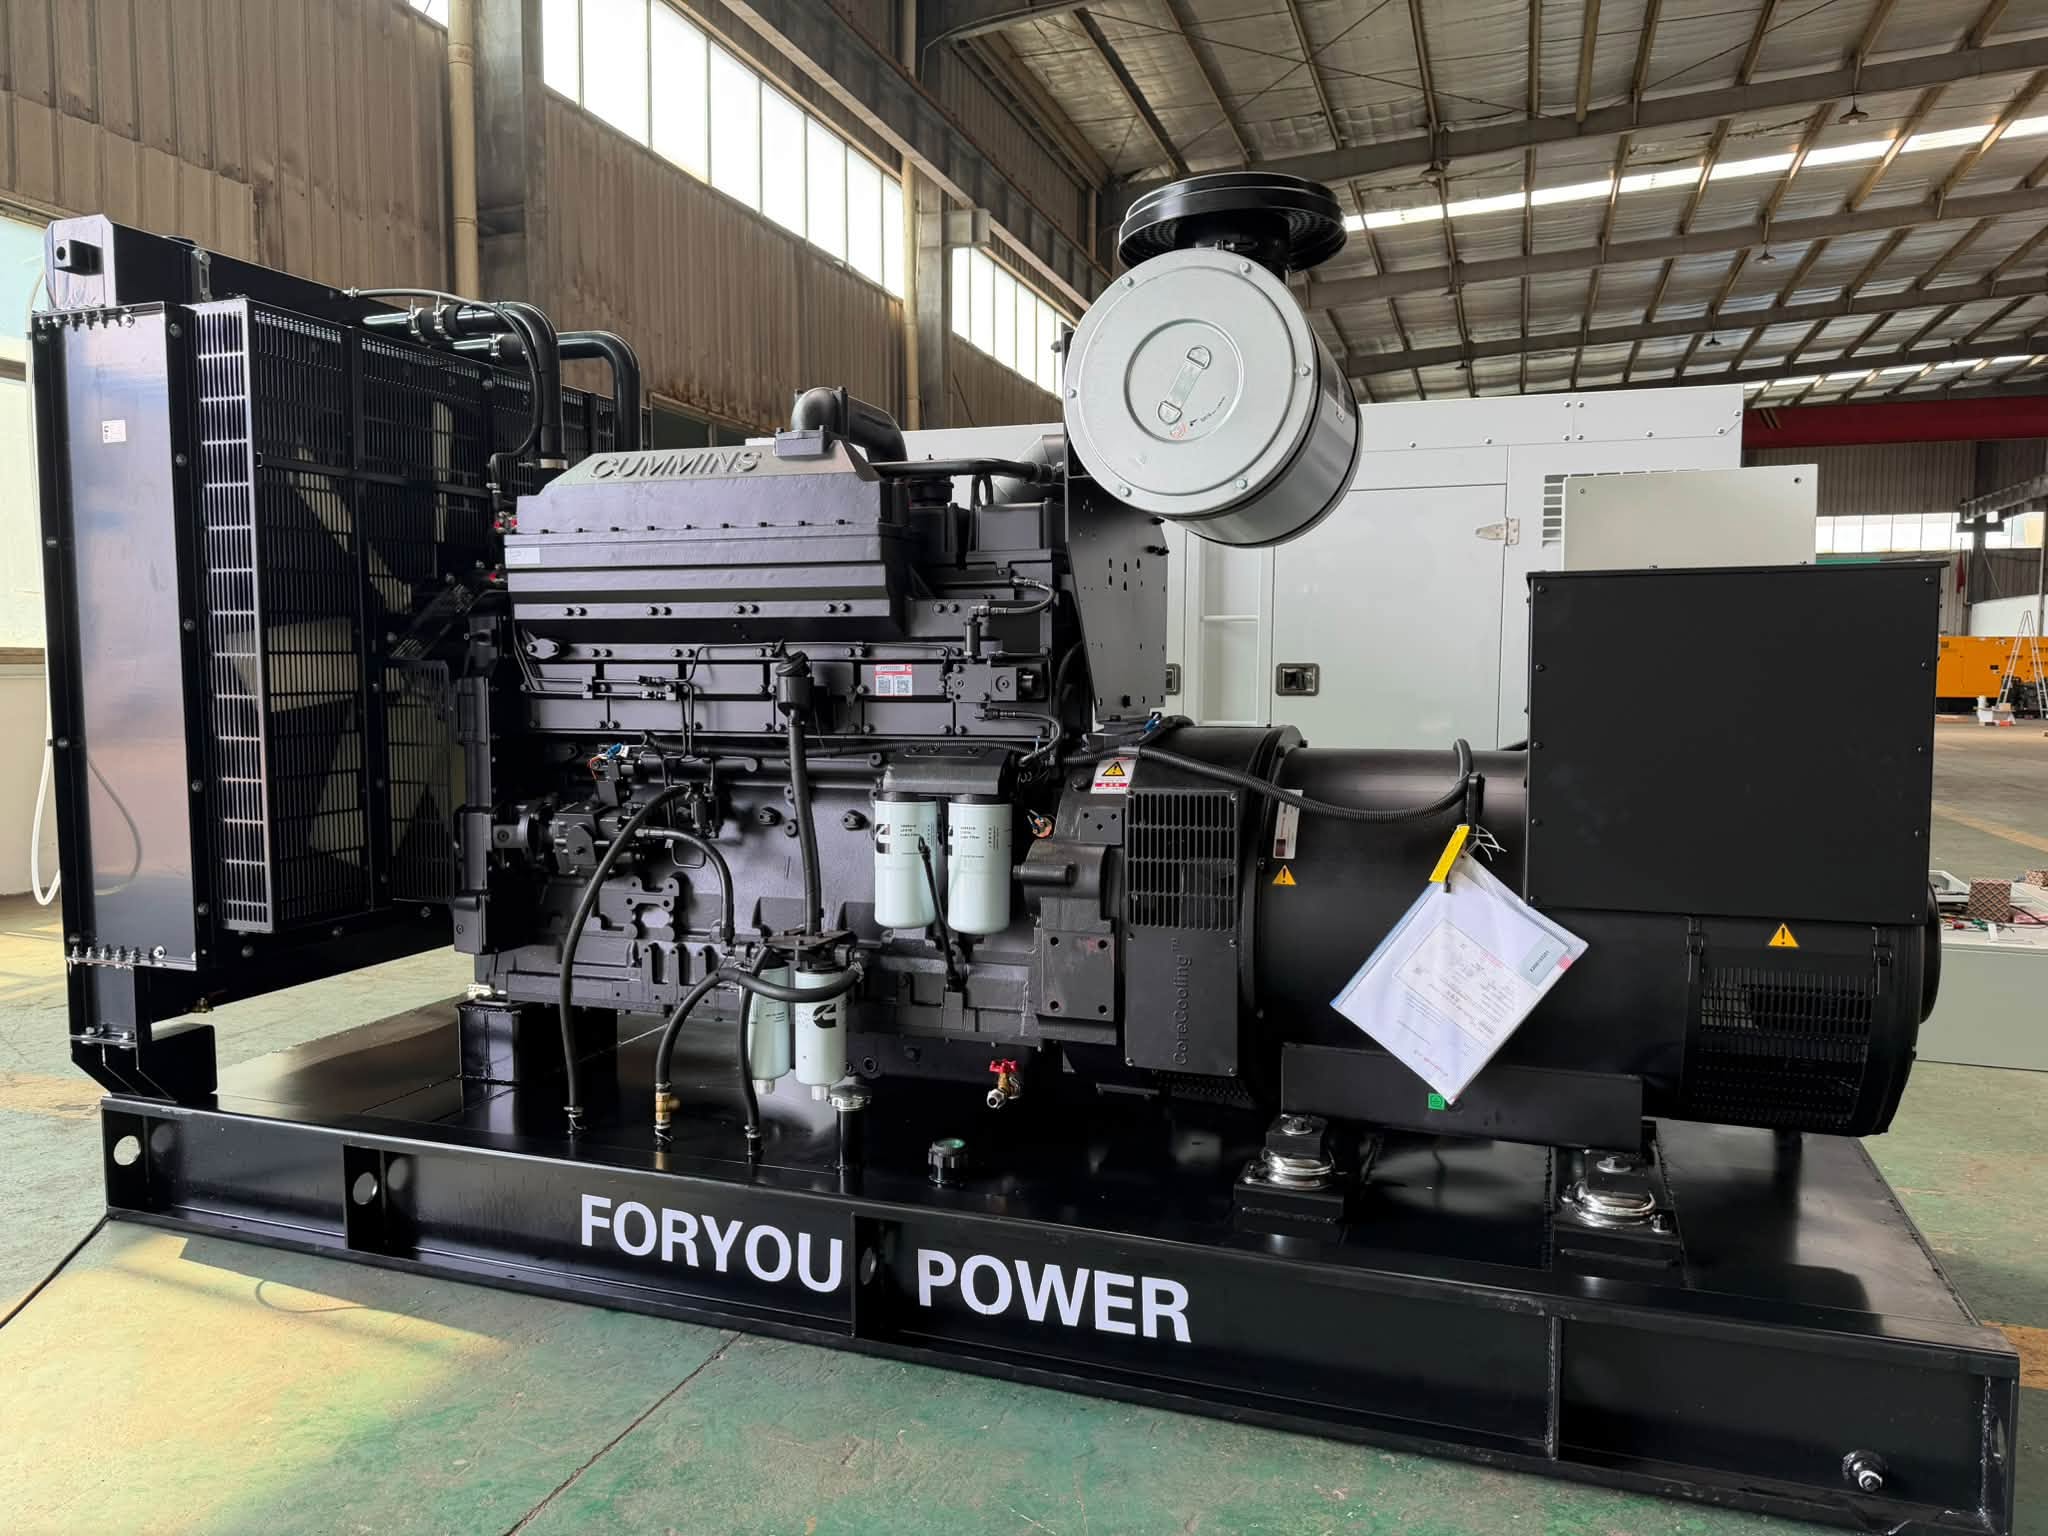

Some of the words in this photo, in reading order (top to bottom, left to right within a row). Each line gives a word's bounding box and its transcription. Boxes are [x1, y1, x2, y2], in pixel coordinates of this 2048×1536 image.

[590, 451, 763, 479] CUMMINS
[581, 1193, 843, 1293] FORYOU
[917, 1248, 1192, 1343] POWER
